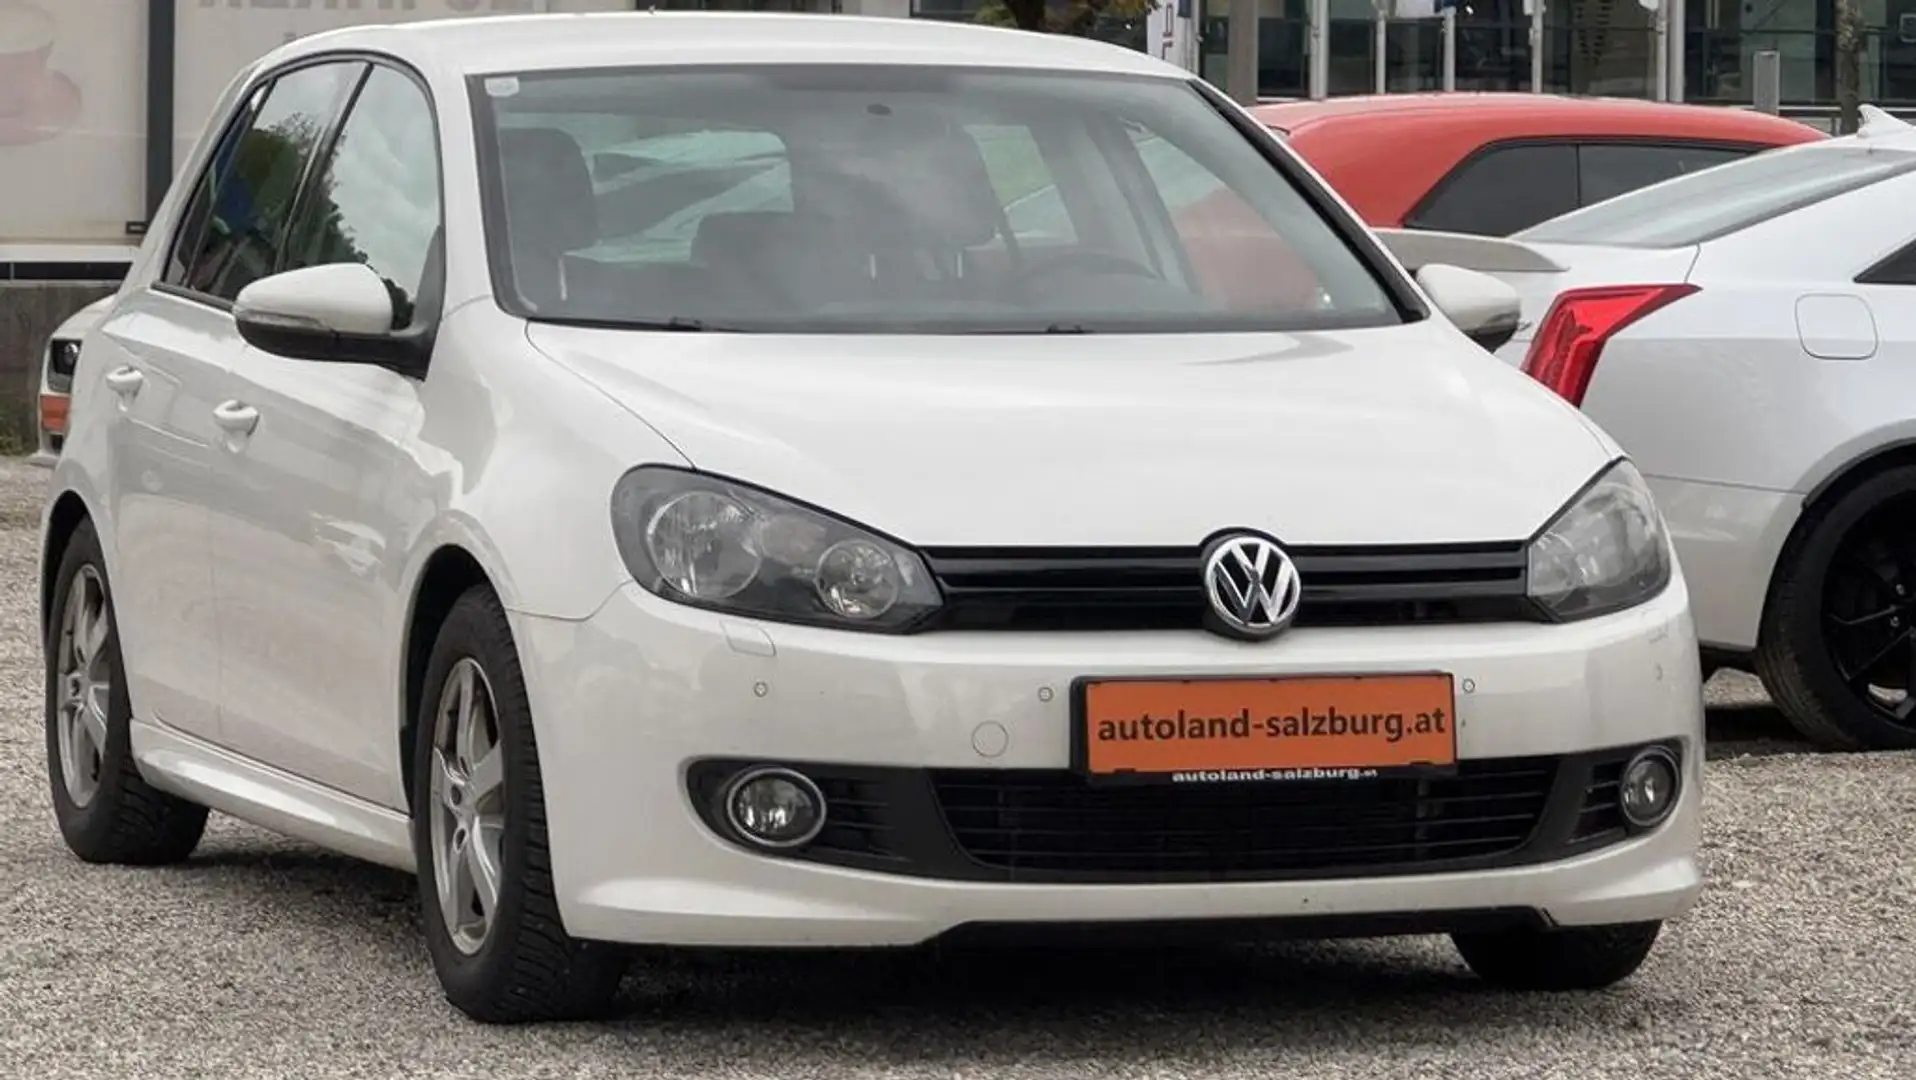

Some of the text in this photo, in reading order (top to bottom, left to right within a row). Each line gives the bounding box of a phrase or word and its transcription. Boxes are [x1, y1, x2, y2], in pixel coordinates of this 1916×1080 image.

[1207, 538, 1300, 630] VW
[1098, 706, 1446, 742] autoland-salzburg.at
[1171, 768, 1378, 783] autoland-salzburg.at
